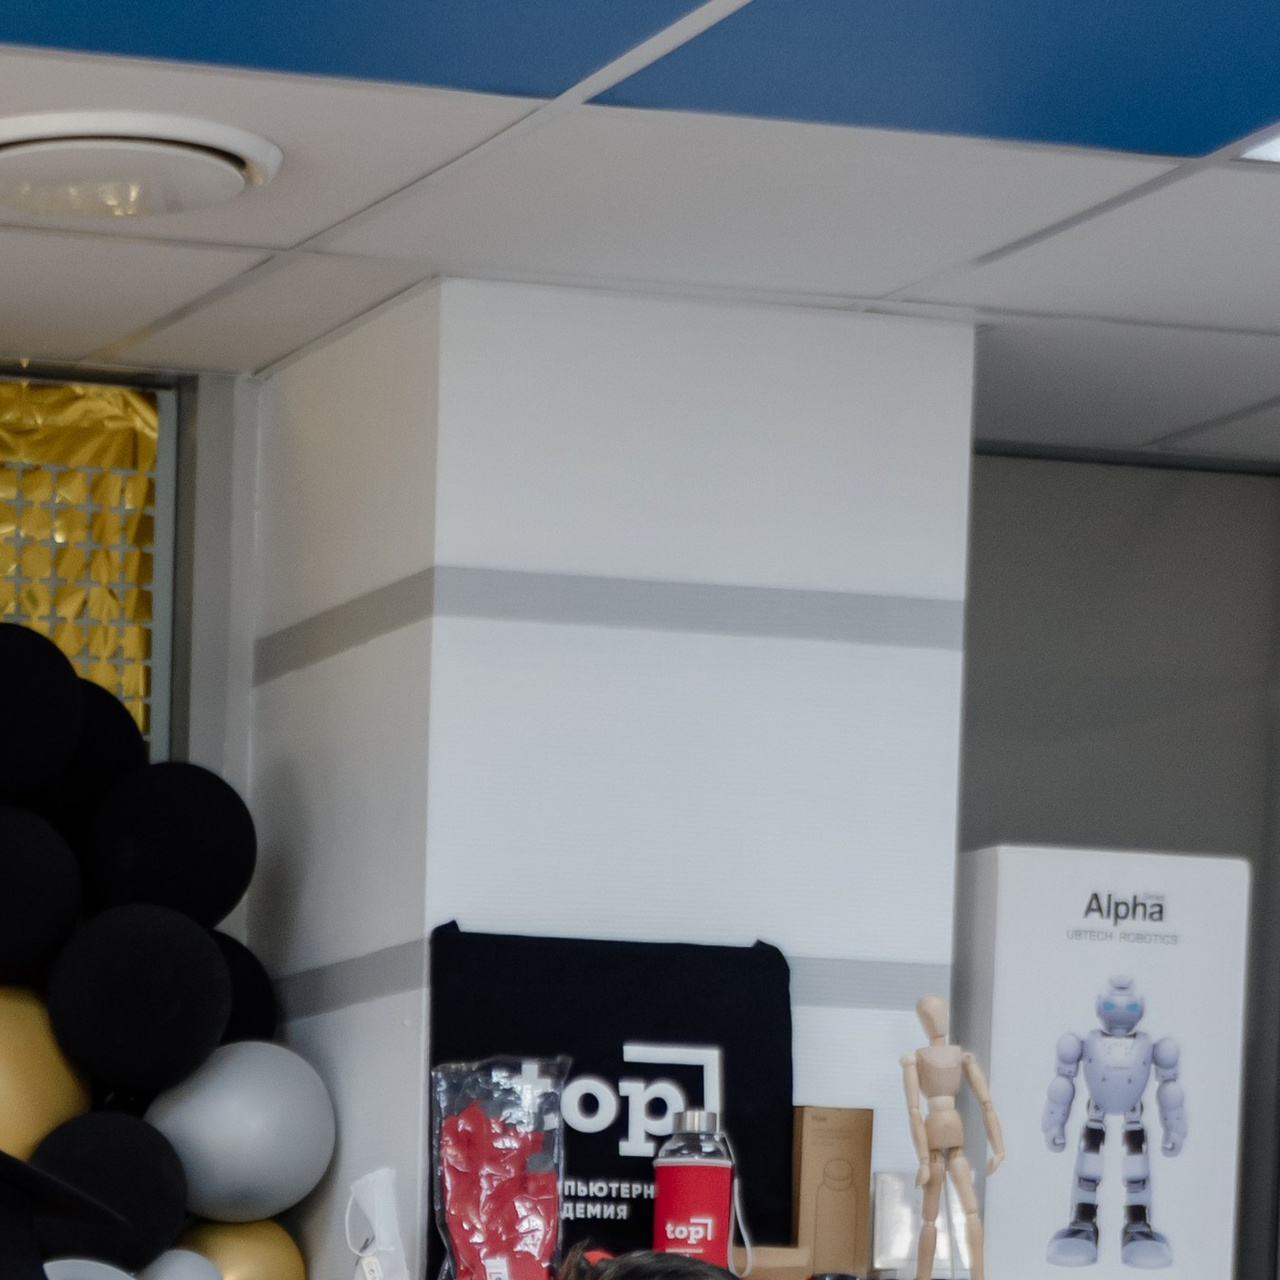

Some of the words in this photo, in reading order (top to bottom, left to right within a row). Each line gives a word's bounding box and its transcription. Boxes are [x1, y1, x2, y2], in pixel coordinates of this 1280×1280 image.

[1082, 892, 1165, 927] Alpha
[513, 1062, 686, 1158] top
[558, 1179, 656, 1199] ПЬЮТЕРН
[665, 1221, 706, 1245] top
